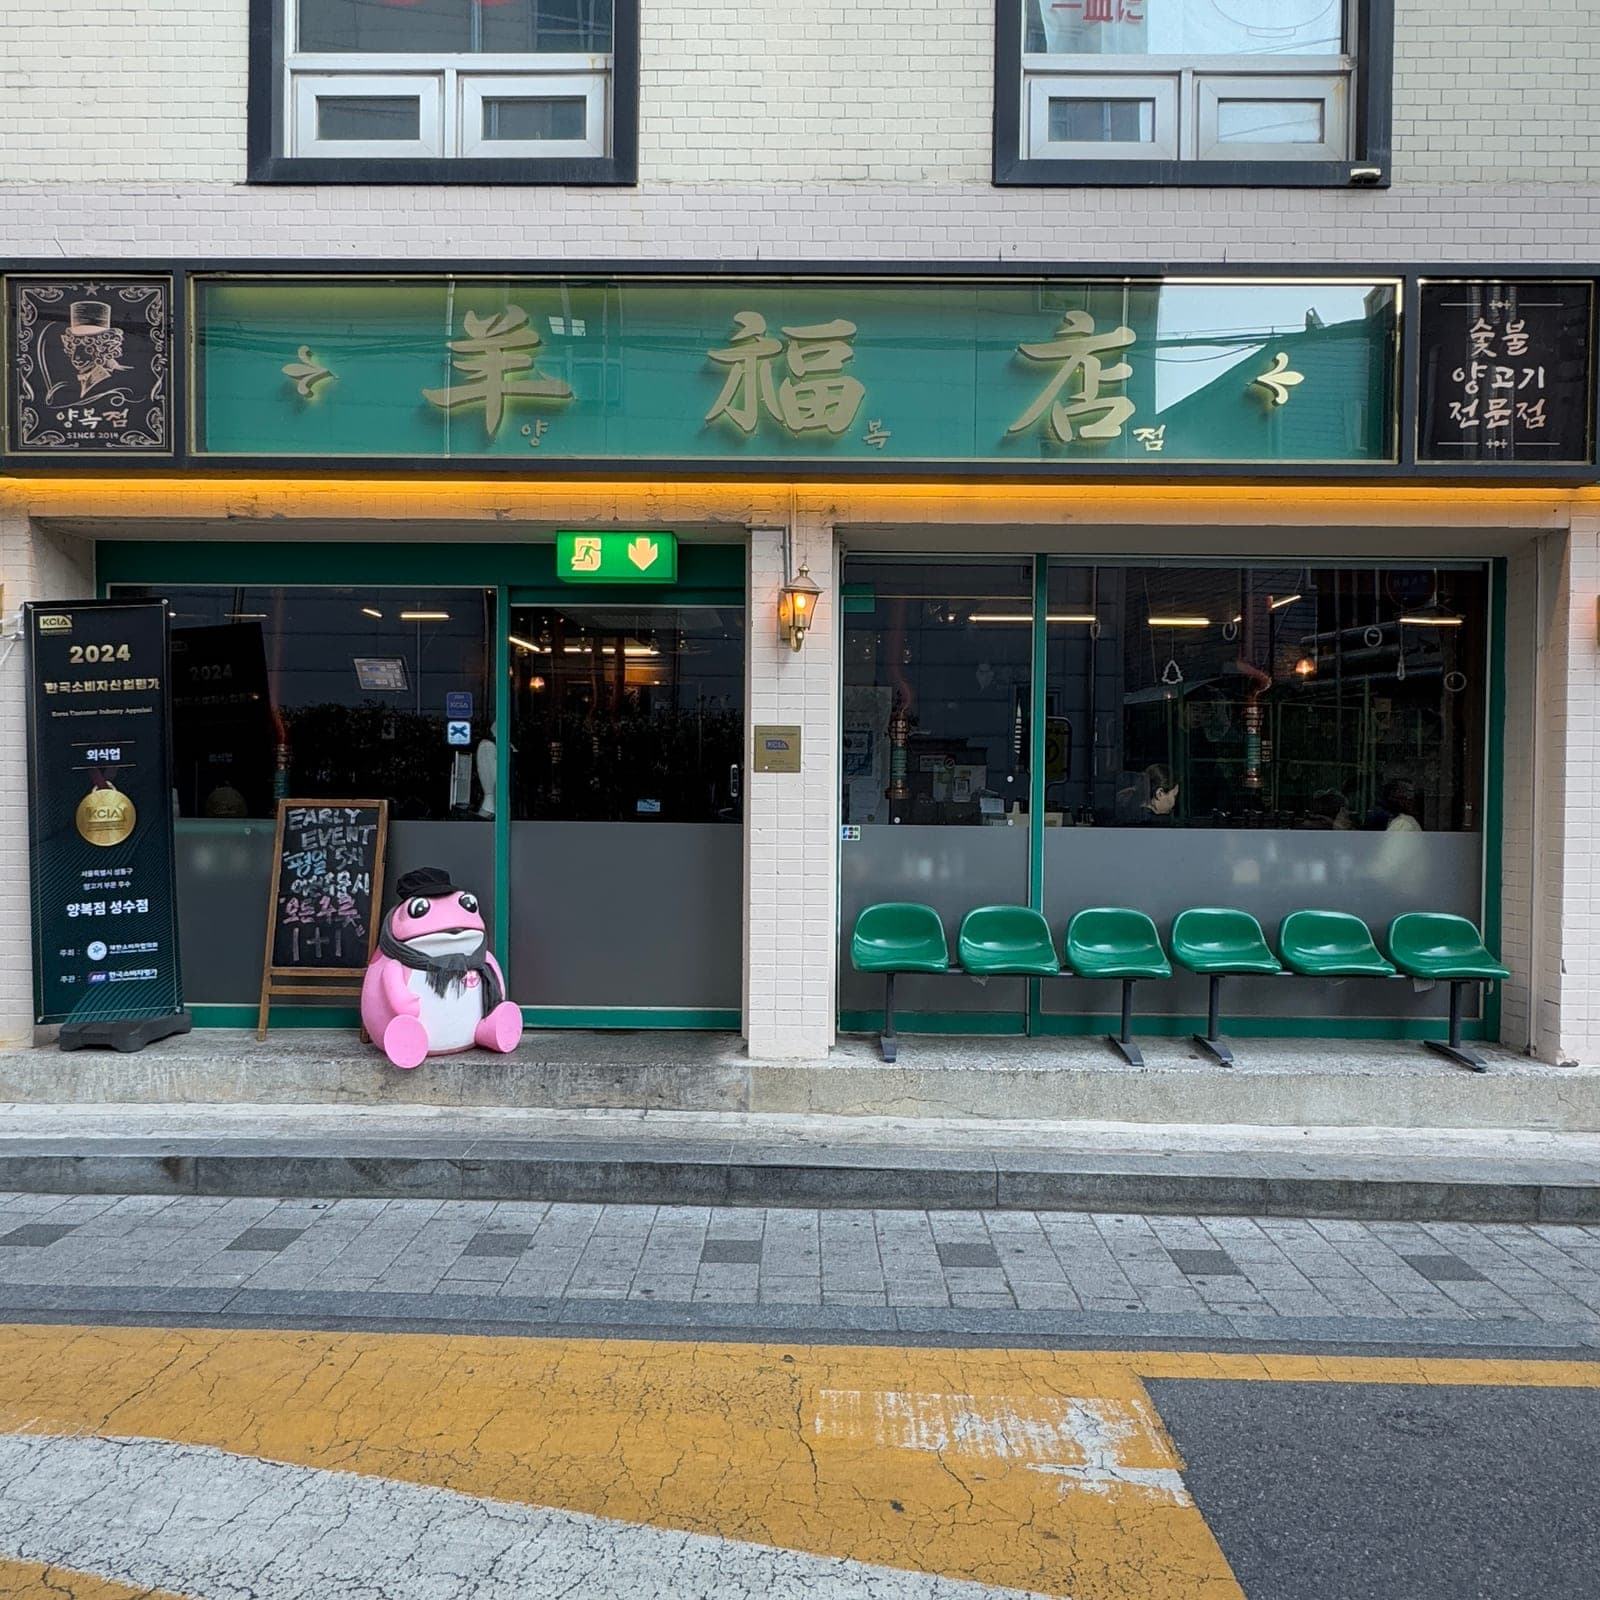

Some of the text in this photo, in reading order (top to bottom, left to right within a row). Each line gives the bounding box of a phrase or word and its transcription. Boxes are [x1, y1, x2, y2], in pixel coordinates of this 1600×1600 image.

[1470, 318, 1531, 358] 숯불
[1452, 361, 1545, 394] 양고기
[56, 407, 130, 429] 양복점
[1448, 398, 1549, 429] 전문점
[520, 419, 550, 447] 양
[1133, 424, 1166, 451] 점
[42, 617, 69, 626] KCIA
[69, 643, 132, 664] 2024
[86, 748, 122, 761] 외식업
[287, 807, 363, 831] EARLY
[301, 823, 378, 850] EVENT
[66, 898, 149, 918] 양복점 성수점
